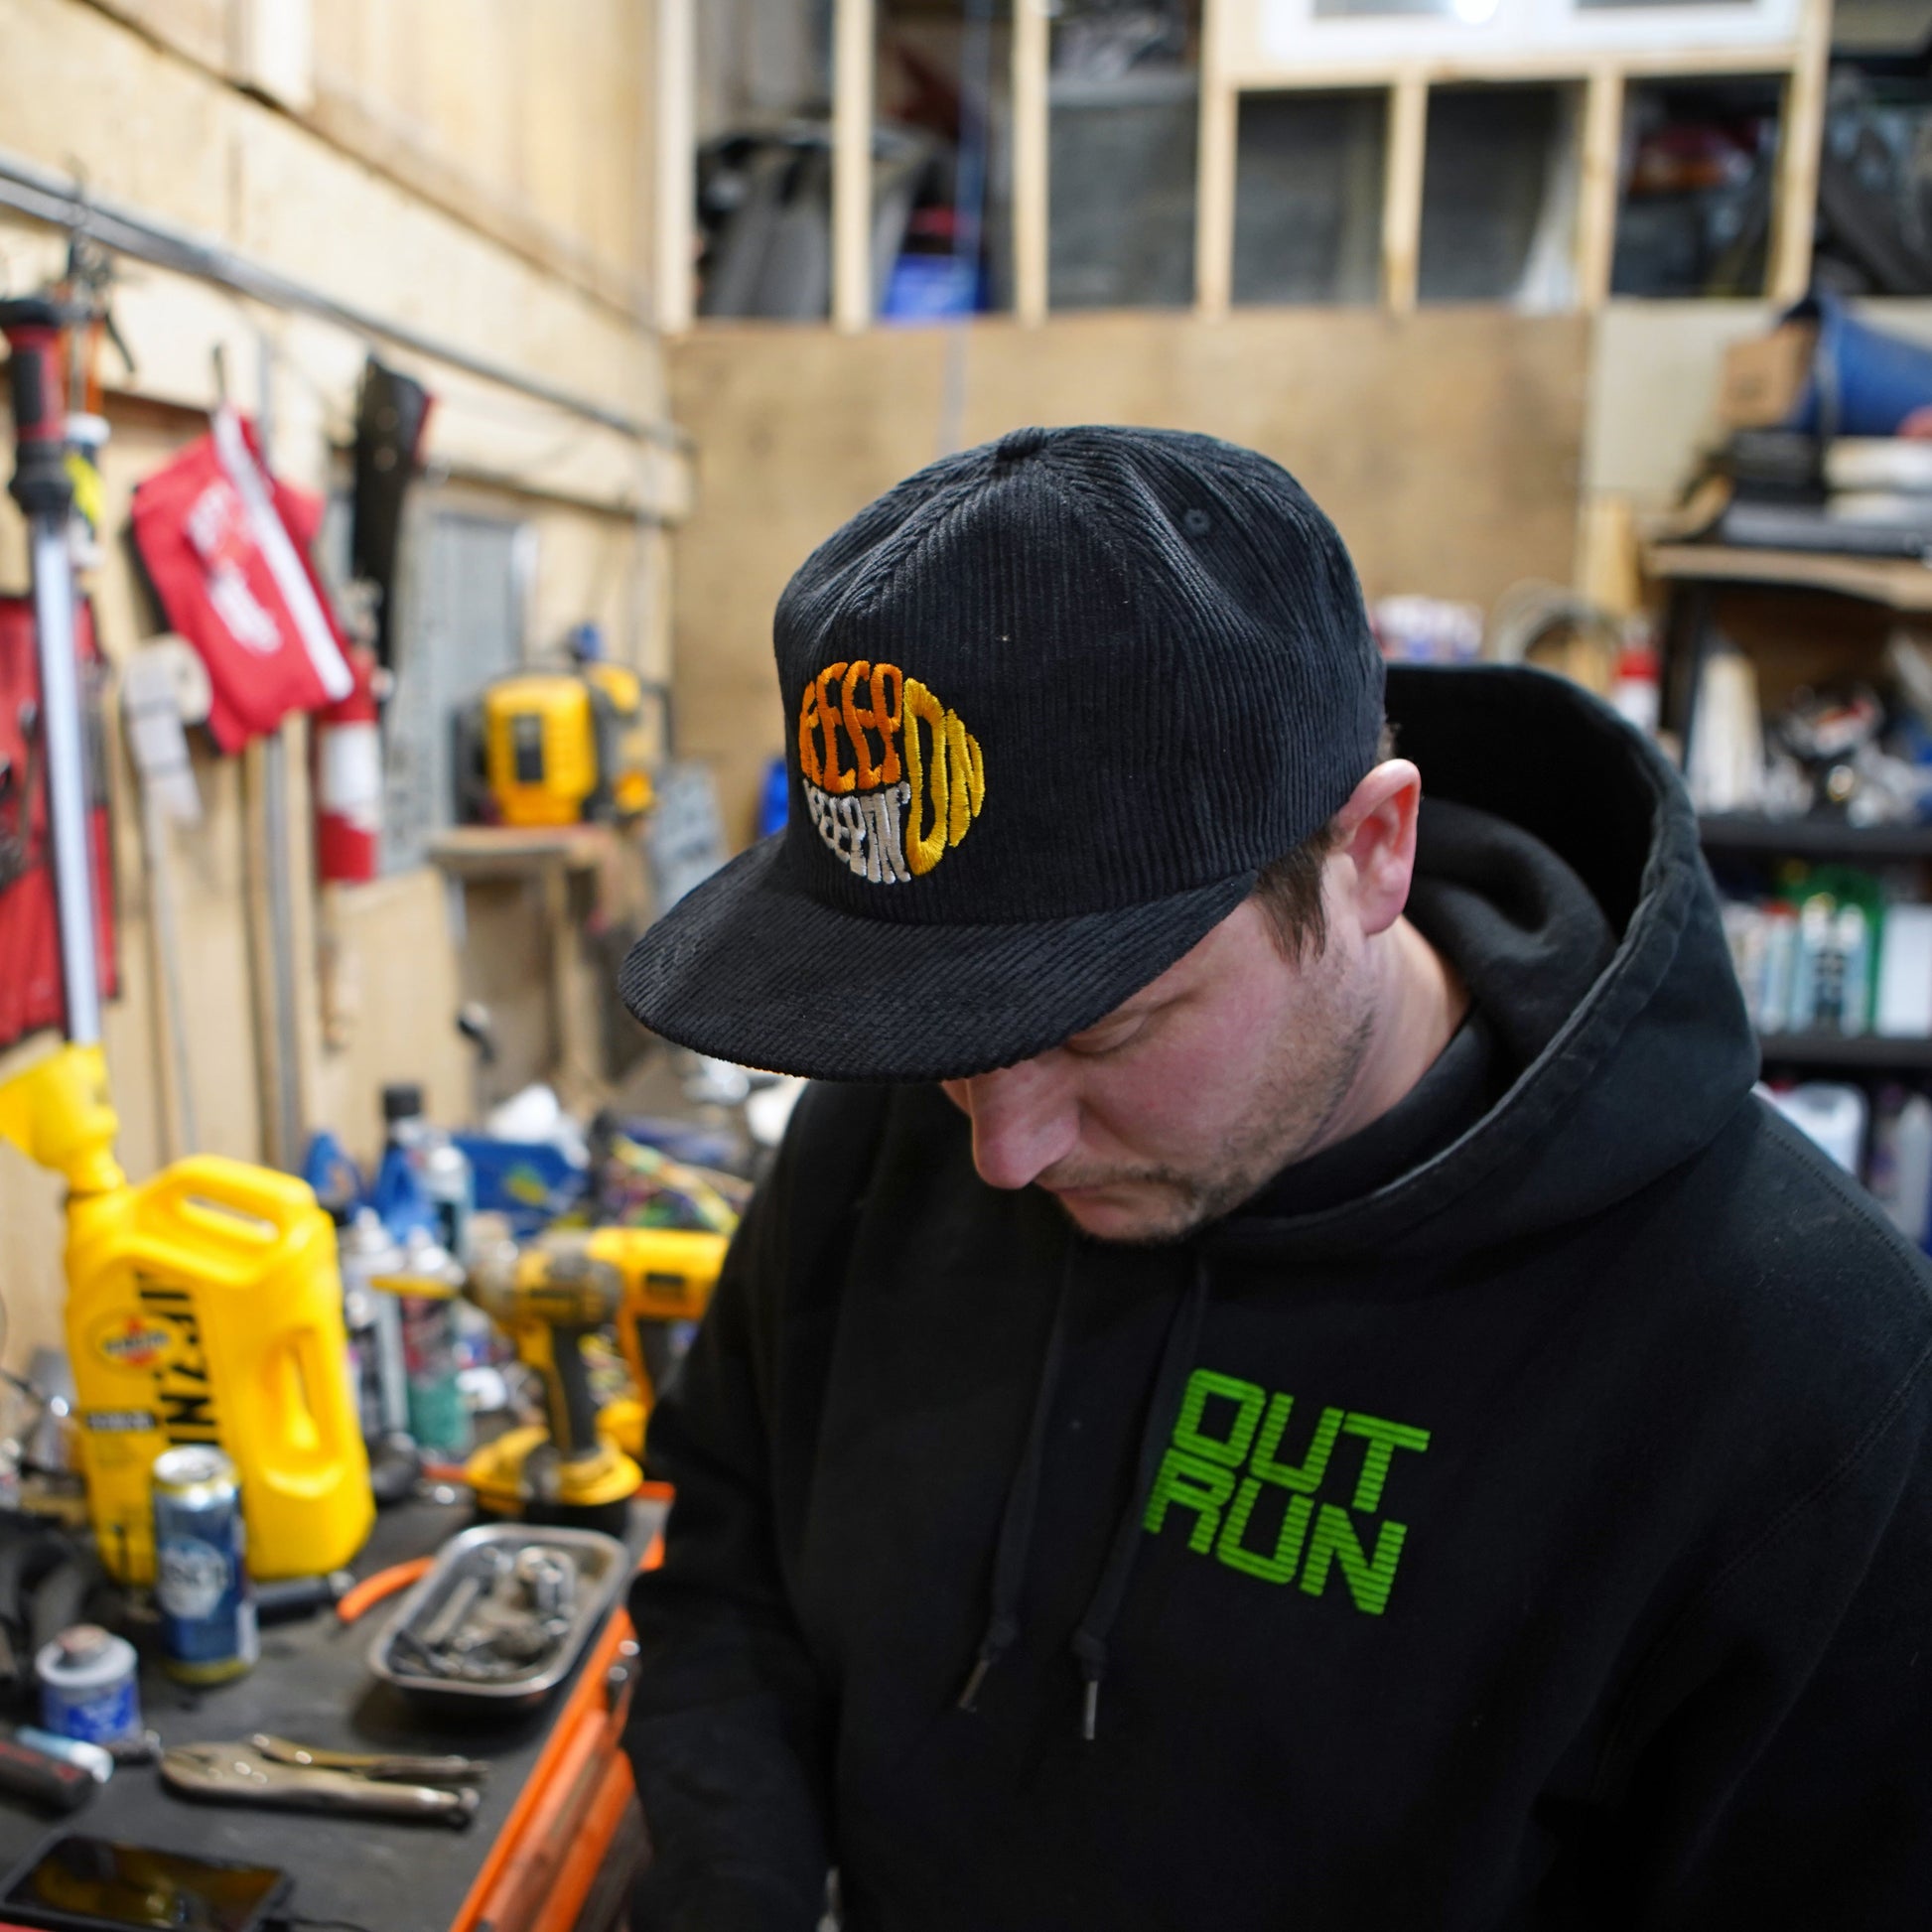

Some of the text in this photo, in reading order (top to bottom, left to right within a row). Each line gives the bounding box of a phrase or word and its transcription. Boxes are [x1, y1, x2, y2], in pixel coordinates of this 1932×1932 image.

[799, 660, 904, 793] KEEP
[902, 677, 986, 877] ON
[1173, 1368, 1432, 1514] OUT
[1142, 1447, 1408, 1615] RUN
